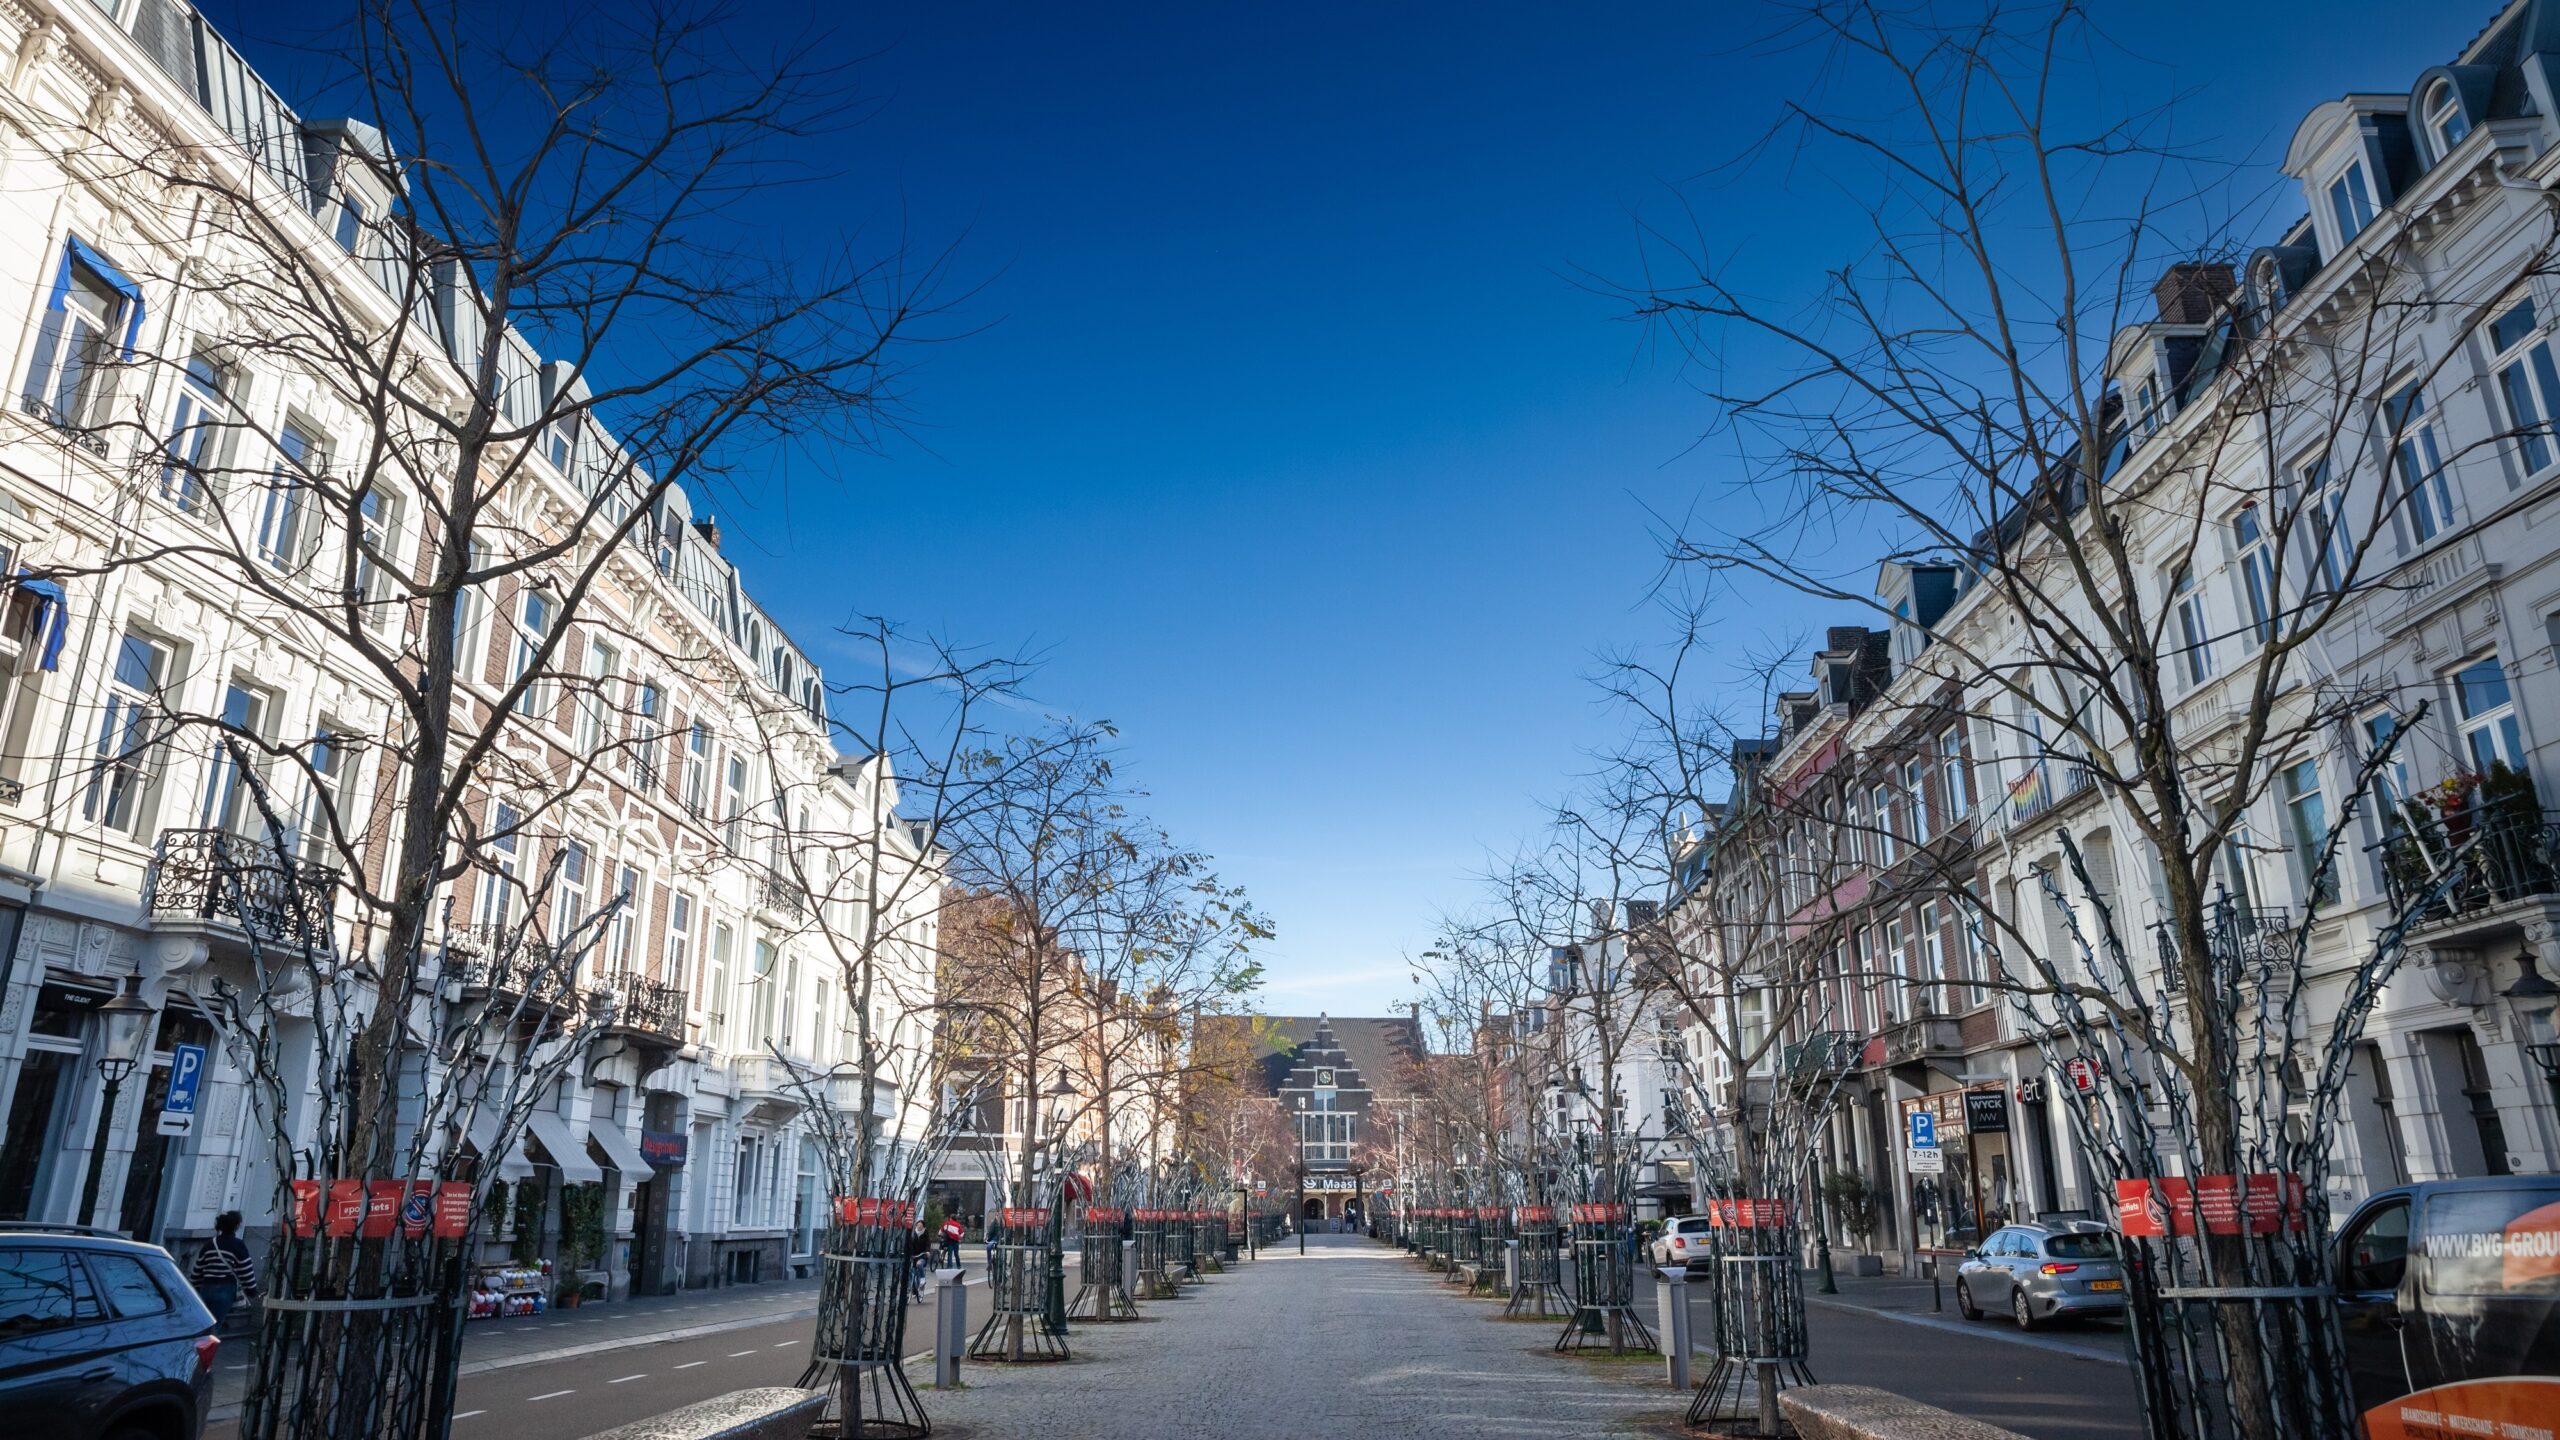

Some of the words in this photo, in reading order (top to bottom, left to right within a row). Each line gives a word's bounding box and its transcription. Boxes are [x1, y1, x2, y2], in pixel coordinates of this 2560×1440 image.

[178, 1052, 197, 1084] P
[2016, 1078, 2041, 1104] alert
[1970, 1100, 2003, 1110] WYCK
[1916, 1116, 1928, 1134] P
[2343, 1192, 2352, 1200] 29
[344, 1202, 390, 1216] #poiets
[2400, 1407, 2442, 1427] BRANDSCHADE
[2448, 1414, 2495, 1436] WATERSCHADE
